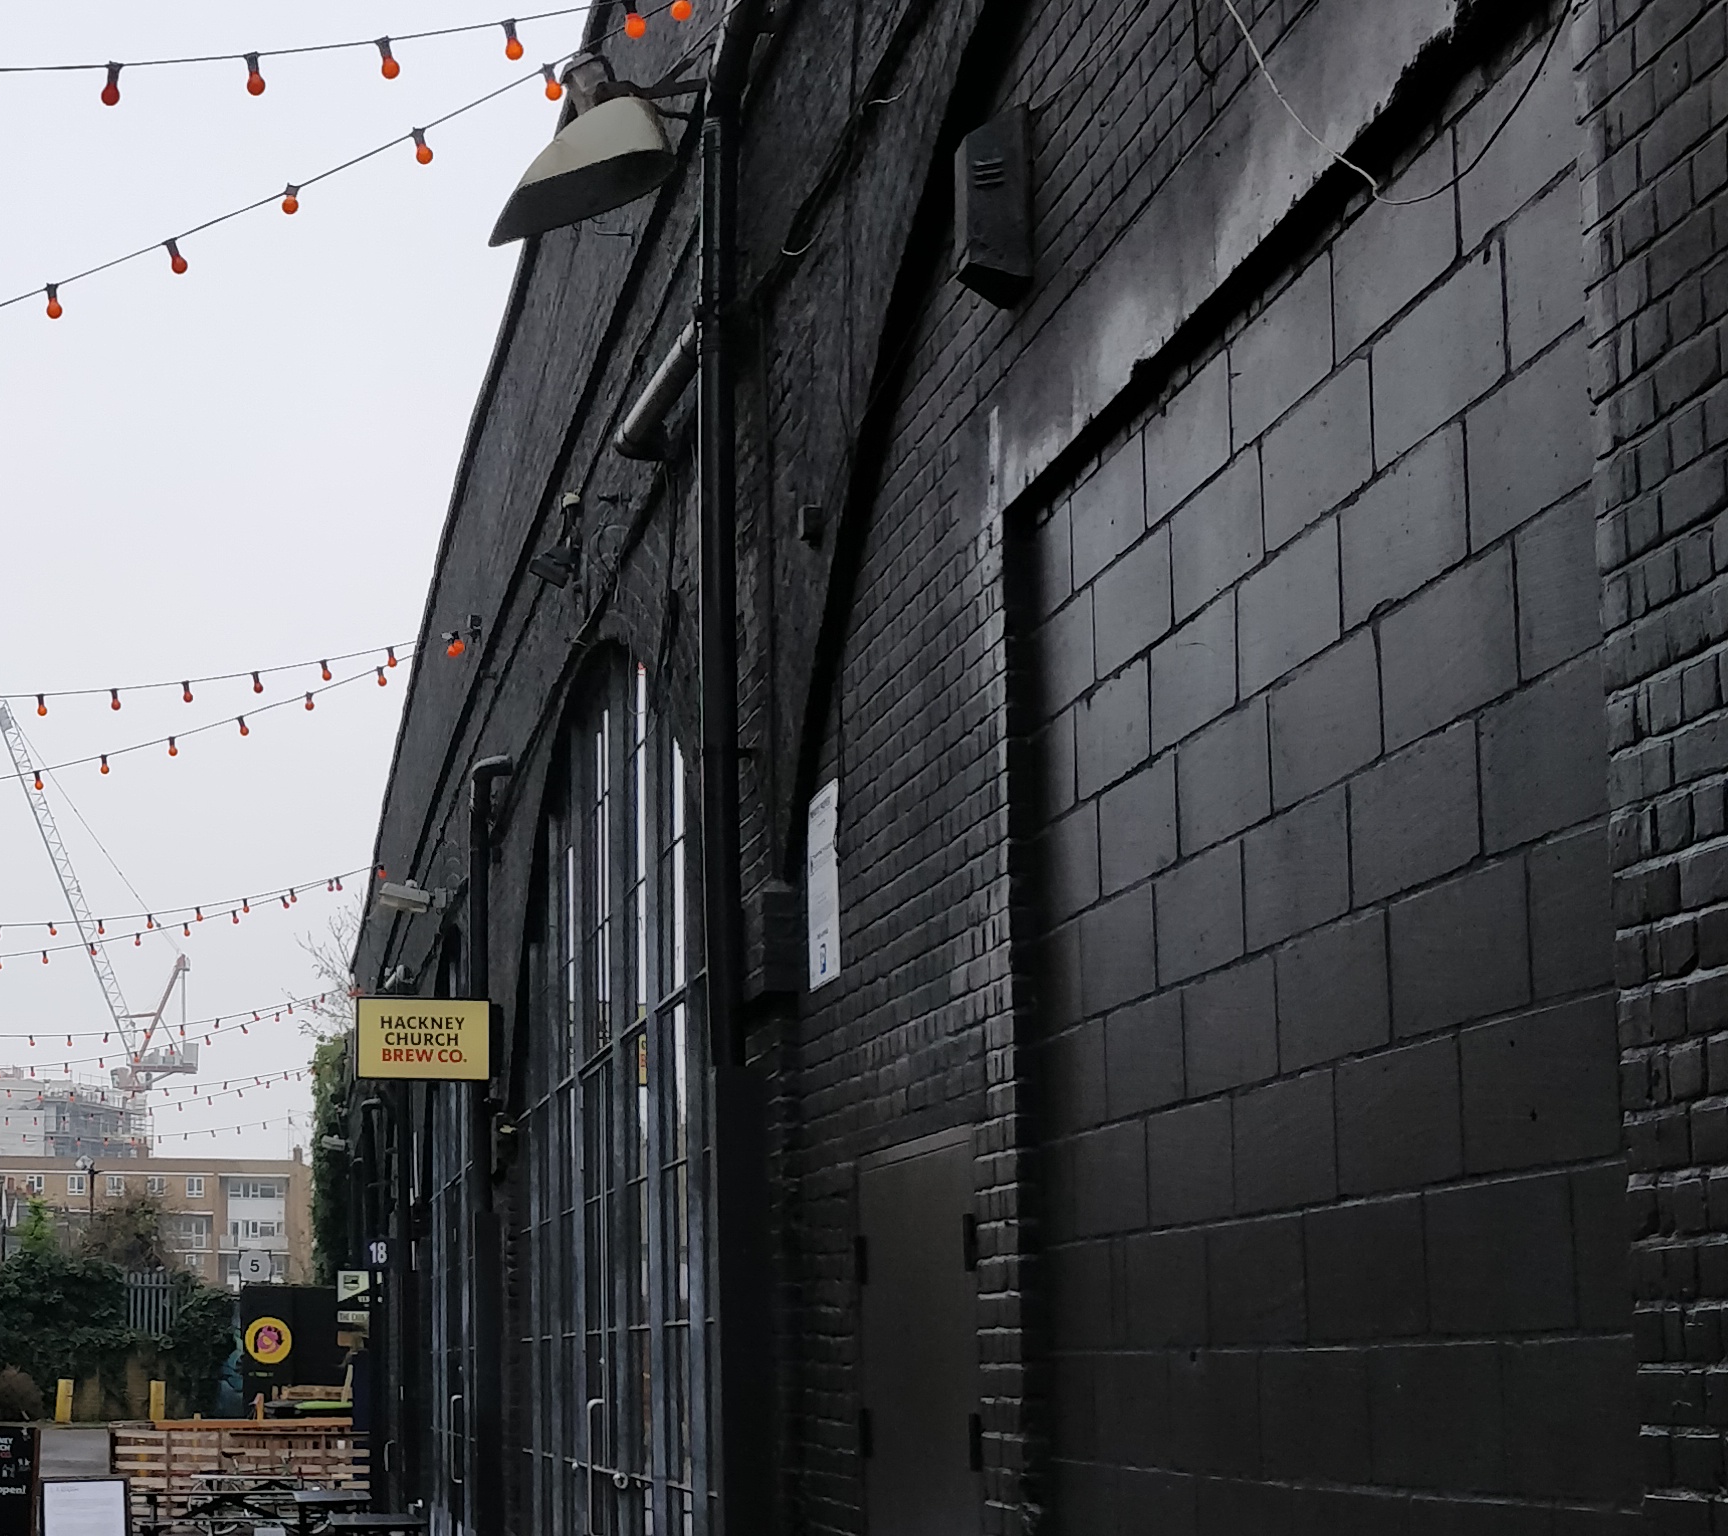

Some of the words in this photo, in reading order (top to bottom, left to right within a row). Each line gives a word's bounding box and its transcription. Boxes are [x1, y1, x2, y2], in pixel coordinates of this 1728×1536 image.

[380, 1015, 465, 1030] HACKNEY
[384, 1032, 459, 1046] CHURCH
[381, 1048, 434, 1062] BREW
[438, 1049, 467, 1063] CO.
[369, 1242, 387, 1263] 18
[250, 1259, 260, 1273] 5
